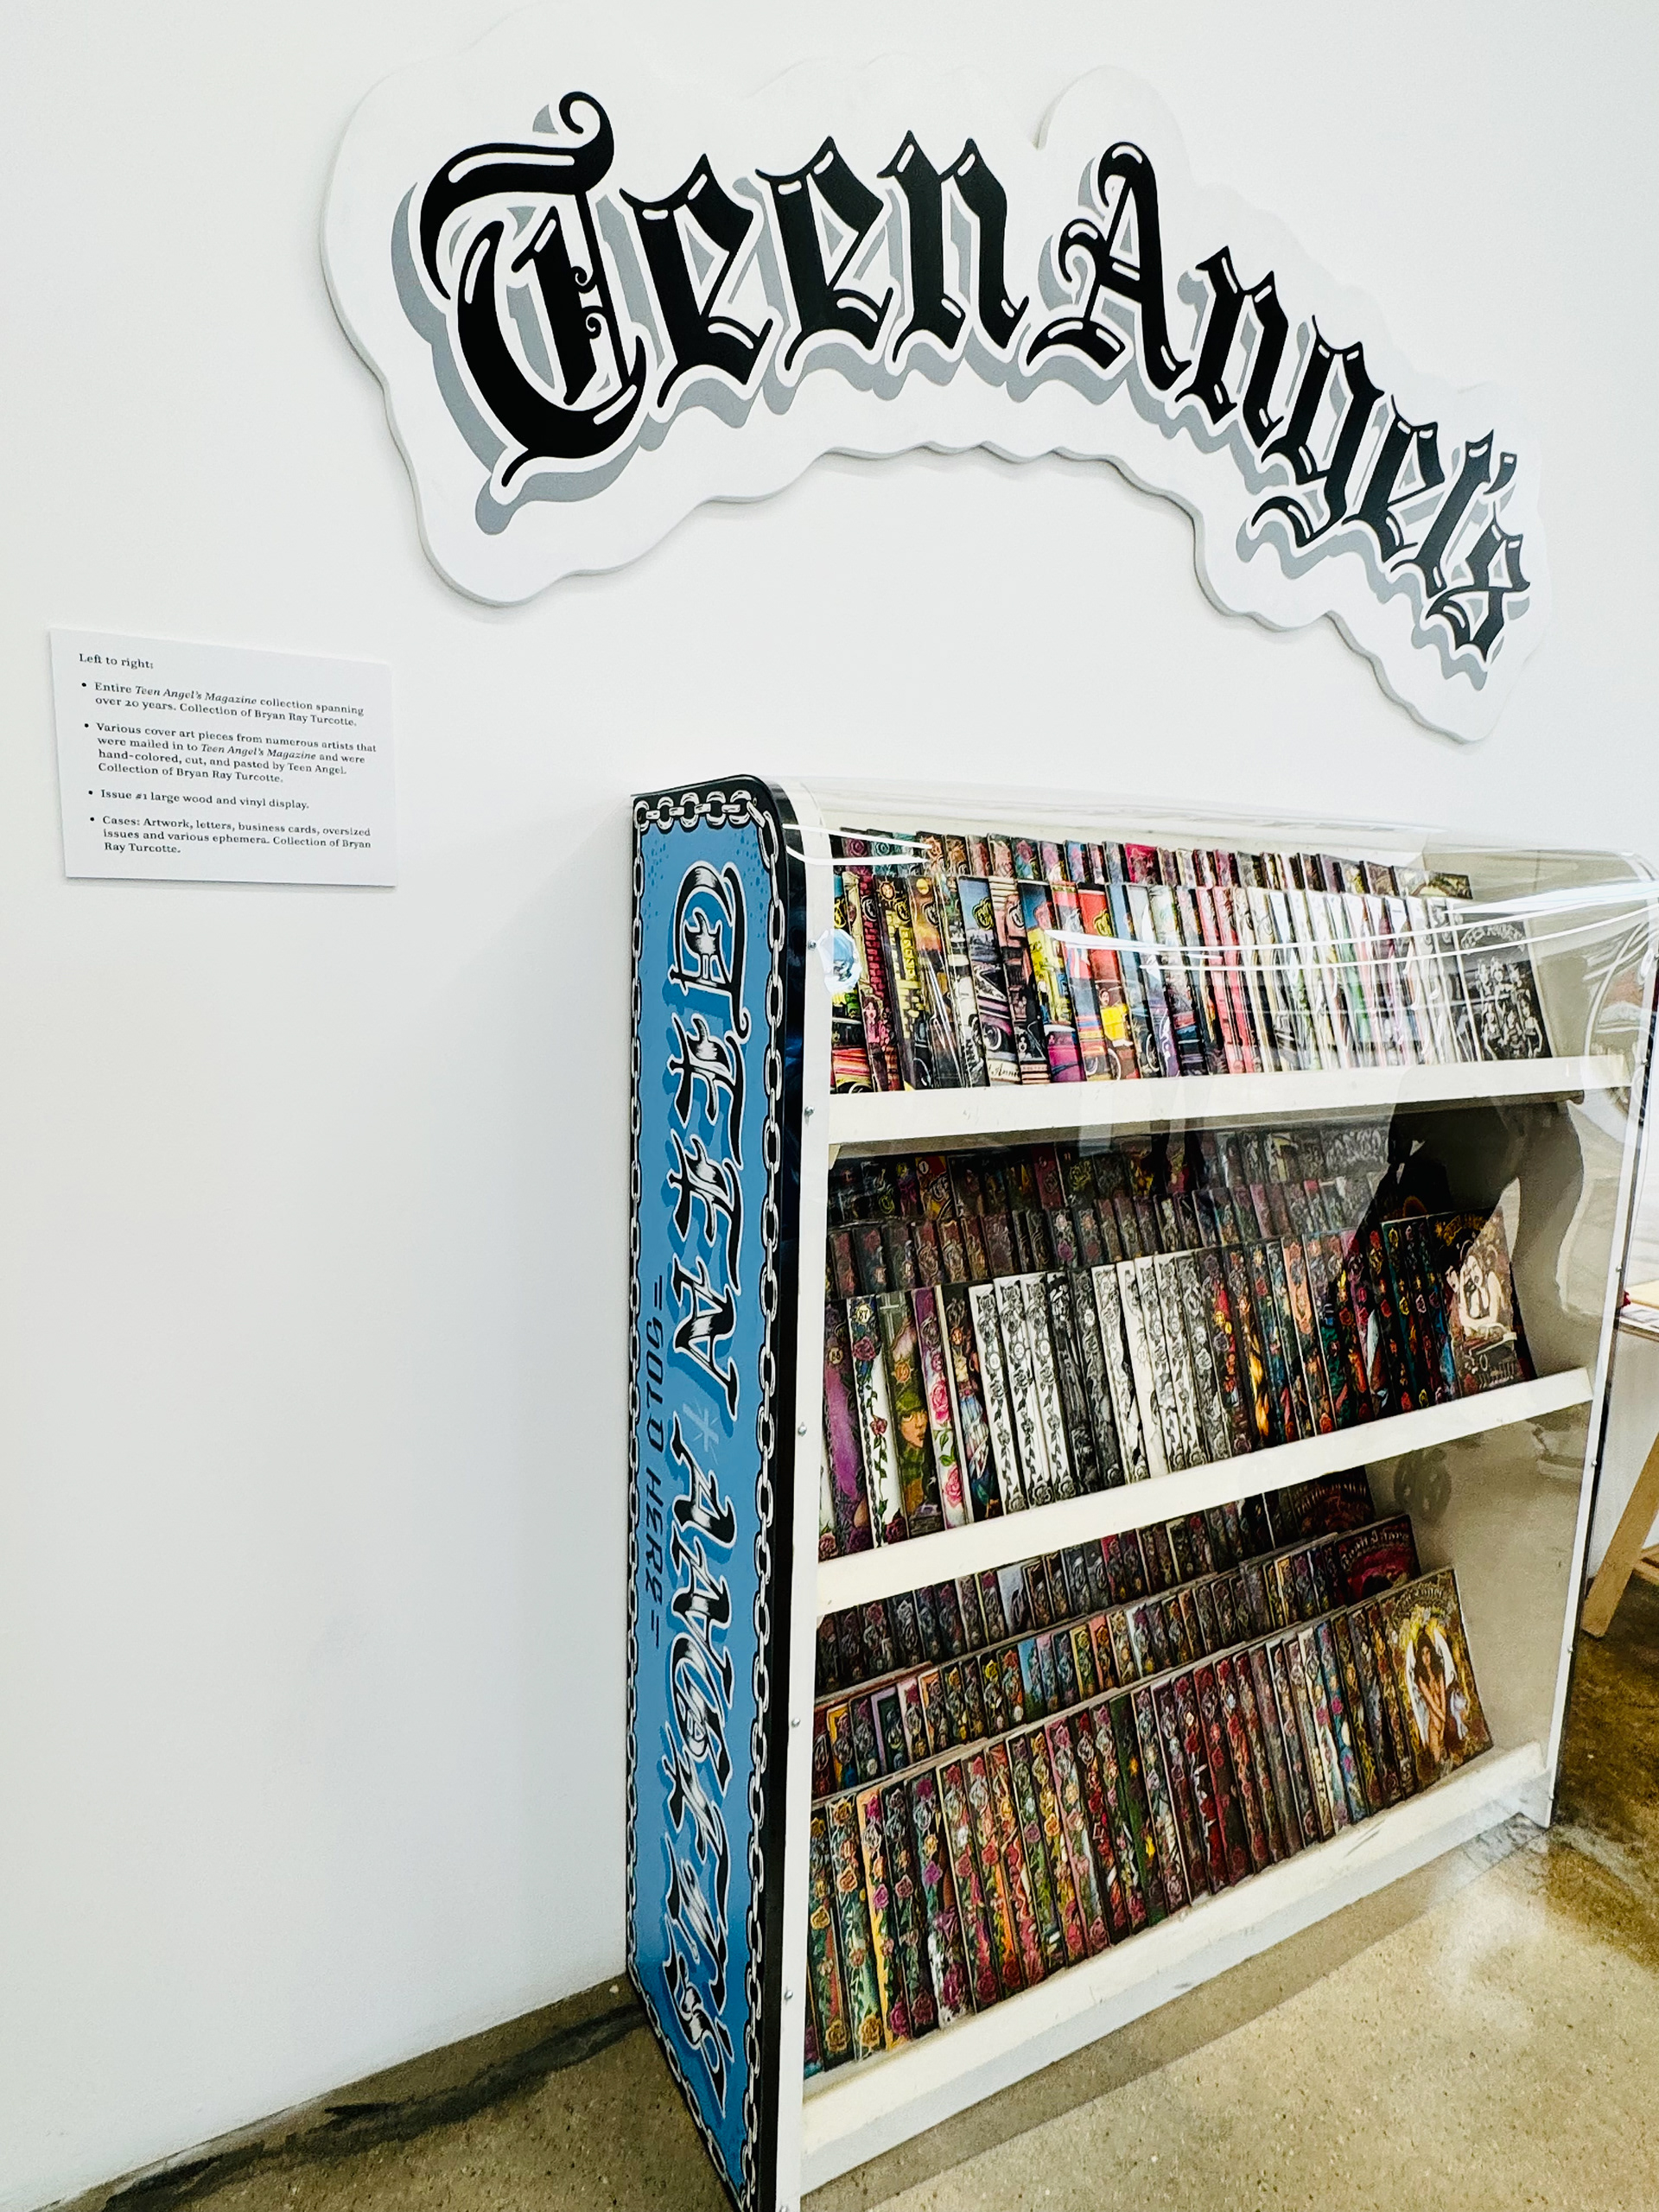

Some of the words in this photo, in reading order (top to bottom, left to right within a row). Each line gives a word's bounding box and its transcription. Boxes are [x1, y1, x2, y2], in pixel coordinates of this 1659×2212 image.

[420, 91, 1029, 486] Teen
[79, 653, 103, 664] Left
[105, 657, 118, 665] to
[121, 658, 154, 670] right:
[94, 682, 132, 694] Entire
[135, 685, 161, 696] Teen
[204, 692, 257, 705] Magazine
[260, 698, 313, 710] collection
[315, 704, 364, 717] spanning
[95, 697, 122, 706] over
[142, 701, 176, 711] years.
[180, 702, 238, 716] Collection
[240, 709, 252, 717] of
[254, 709, 286, 721] Bryan
[288, 712, 308, 724] Ray
[310, 714, 357, 726] Turcotte.
[95, 722, 142, 734] Various
[144, 728, 176, 737] cover
[179, 730, 195, 739] art
[198, 731, 233, 741] pieces
[237, 733, 263, 744] from
[265, 737, 319, 747] numerous
[321, 741, 354, 751] artists
[356, 743, 376, 753] that
[97, 737, 126, 747] were
[130, 739, 169, 749] mailed
[172, 741, 184, 751] in
[187, 743, 199, 752] to
[200, 743, 225, 753] Teen
[266, 748, 316, 760] Magazine
[319, 753, 339, 762] and
[340, 755, 365, 764] were
[98, 748, 182, 763] hand-colored,
[185, 757, 207, 766] cut,
[209, 757, 231, 766] and
[233, 760, 270, 770] pasted
[272, 760, 285, 772] by
[287, 762, 312, 772] Teen
[315, 765, 346, 776] Angel.
[98, 762, 159, 774] Collection
[162, 766, 175, 776] of
[175, 767, 209, 779] Bryan
[212, 770, 232, 781] Ray
[234, 771, 283, 783] Turcotte.
[100, 789, 132, 799] Issue
[150, 791, 180, 804] large
[182, 795, 213, 804] wood
[216, 796, 237, 805] and
[239, 797, 266, 809] vinyl
[269, 798, 309, 811] display.
[102, 816, 140, 826] Cases:
[143, 817, 194, 830] Artwork,
[196, 819, 235, 832] letters,
[238, 822, 285, 832] business
[288, 825, 320, 836] cards,
[322, 827, 371, 836] oversized
[103, 828, 140, 839] issues
[143, 830, 165, 840] and
[167, 831, 209, 842] various
[212, 834, 270, 844] ephemera.
[273, 836, 327, 846] Collection
[329, 838, 340, 847] of
[342, 839, 371, 849] Bryan
[104, 842, 126, 854] Ray
[128, 842, 181, 853] Turcotte.
[666, 861, 749, 1420] TEEN
[646, 1318, 664, 1452] SOLD
[645, 1467, 664, 1602] HERE
